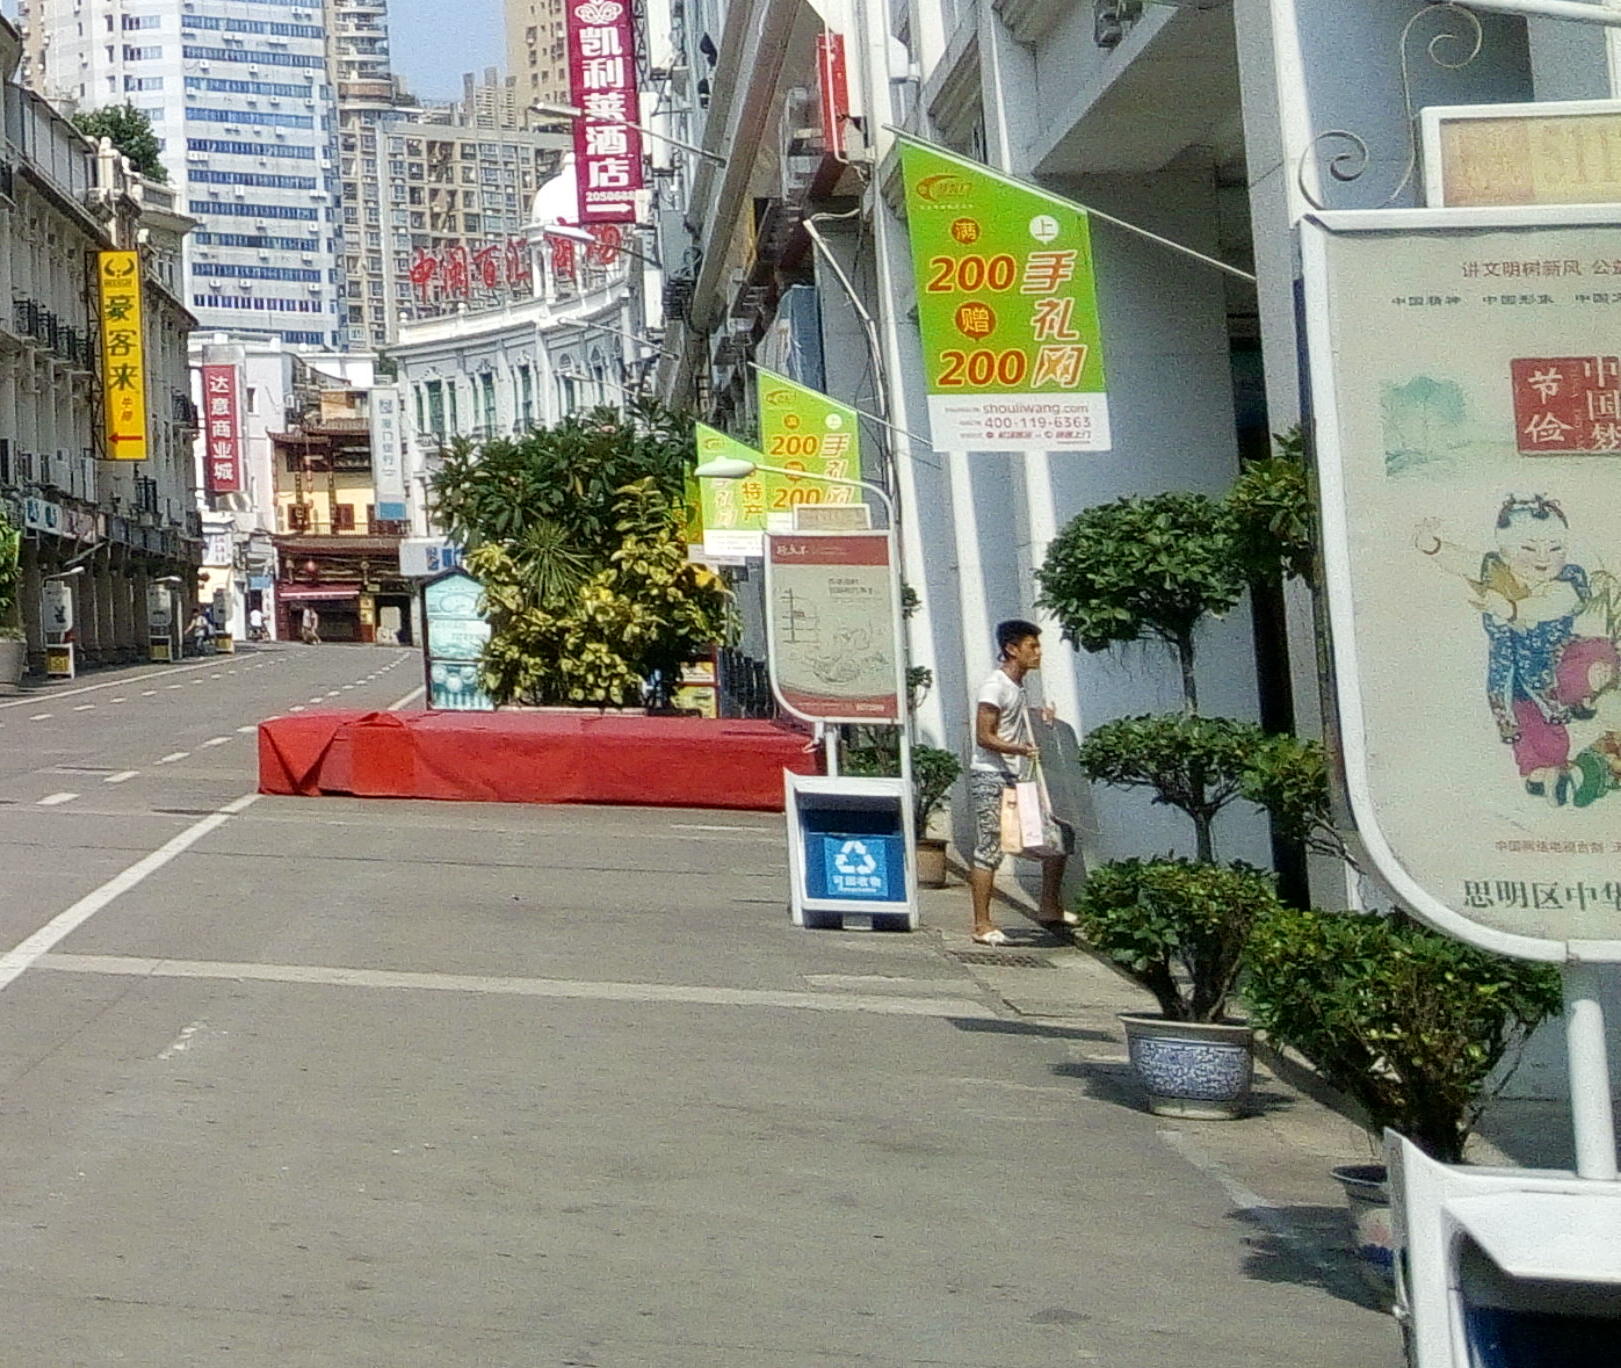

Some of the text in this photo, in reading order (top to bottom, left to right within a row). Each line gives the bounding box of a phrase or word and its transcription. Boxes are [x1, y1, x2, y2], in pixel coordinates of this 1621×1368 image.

[578, 25, 631, 190] 凯利莱酒店
[956, 221, 977, 241] 满
[925, 252, 1017, 294] 200
[1462, 260, 1583, 278] 讲文明树新风
[960, 307, 991, 334] 赠
[1020, 248, 1088, 389] 手礼网
[105, 294, 139, 391] 豪客来
[936, 347, 1028, 388] 200
[983, 403, 1089, 416] shouliwang.com
[1524, 366, 1575, 444] 节俭
[209, 375, 234, 481] 达意商业城
[984, 416, 1092, 430] 400-119-6363
[770, 435, 818, 456] 200
[772, 487, 822, 509] 200
